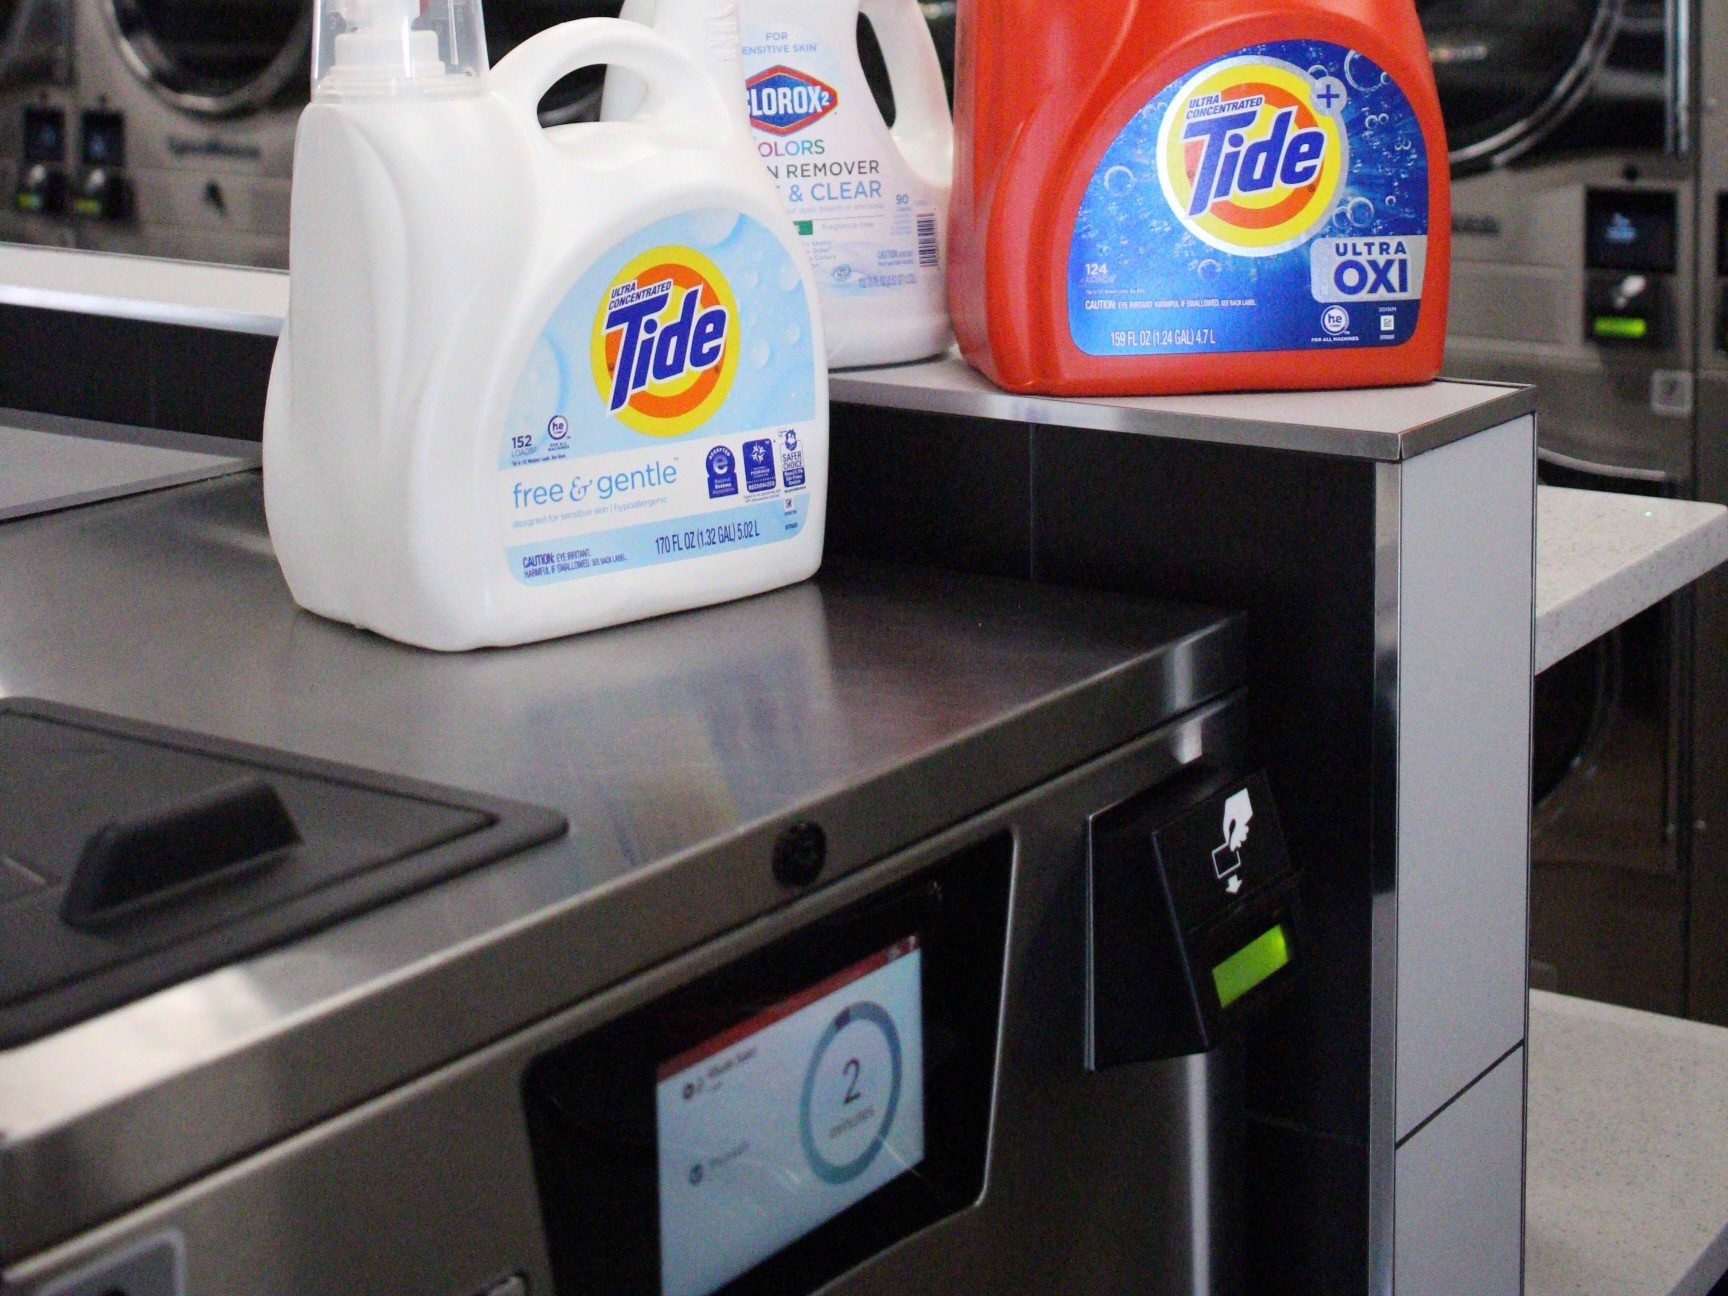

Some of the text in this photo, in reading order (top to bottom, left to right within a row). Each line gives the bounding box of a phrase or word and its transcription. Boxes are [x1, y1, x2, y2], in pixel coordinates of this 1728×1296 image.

[766, 32, 788, 41] FOR
[742, 43, 817, 55] ENSITIVE SKIN
[746, 86, 830, 116] LOROX2
[1186, 96, 1263, 120] CONCENTRATED
[1188, 94, 1220, 108] ULTRA
[758, 139, 826, 158] OLORS
[786, 160, 880, 178] REMOVER
[1183, 110, 1325, 216] Tide
[788, 180, 882, 202] & CLEAR
[896, 194, 909, 204] 90
[1335, 241, 1407, 256] ULTRA
[1085, 264, 1108, 275] 124
[1334, 258, 1408, 296] OXI
[608, 280, 672, 310] CONCENTRATED
[611, 282, 636, 298] ULTRA
[1085, 300, 1116, 310] CAUTION:
[1110, 328, 1216, 347] 159 FL OZ (1.24 GAL) 4.7 L
[606, 289, 727, 411] Tide
[512, 434, 532, 449] 152
[708, 447, 731, 460] ACCEPTED
[782, 450, 802, 462] SAFER
[783, 460, 803, 470] CHOICE
[512, 482, 564, 509] free
[569, 476, 594, 502] &
[596, 460, 678, 500] gentle
[748, 481, 776, 490] RECOGNIZED
[550, 512, 560, 522] for
[560, 508, 592, 520] sensitive
[594, 504, 609, 515] skin
[613, 496, 668, 514] hypoallergenic
[655, 520, 760, 554] 170 FL OZ (1.32 GAL) 5.02 L
[522, 548, 592, 568] CAUTION: EYE IRRITANT.
[524, 566, 551, 578] HARMFUL
[551, 565, 556, 574] IF
[592, 558, 601, 567] SEE
[600, 556, 613, 565] BACK
[842, 1057, 862, 1106] 2
